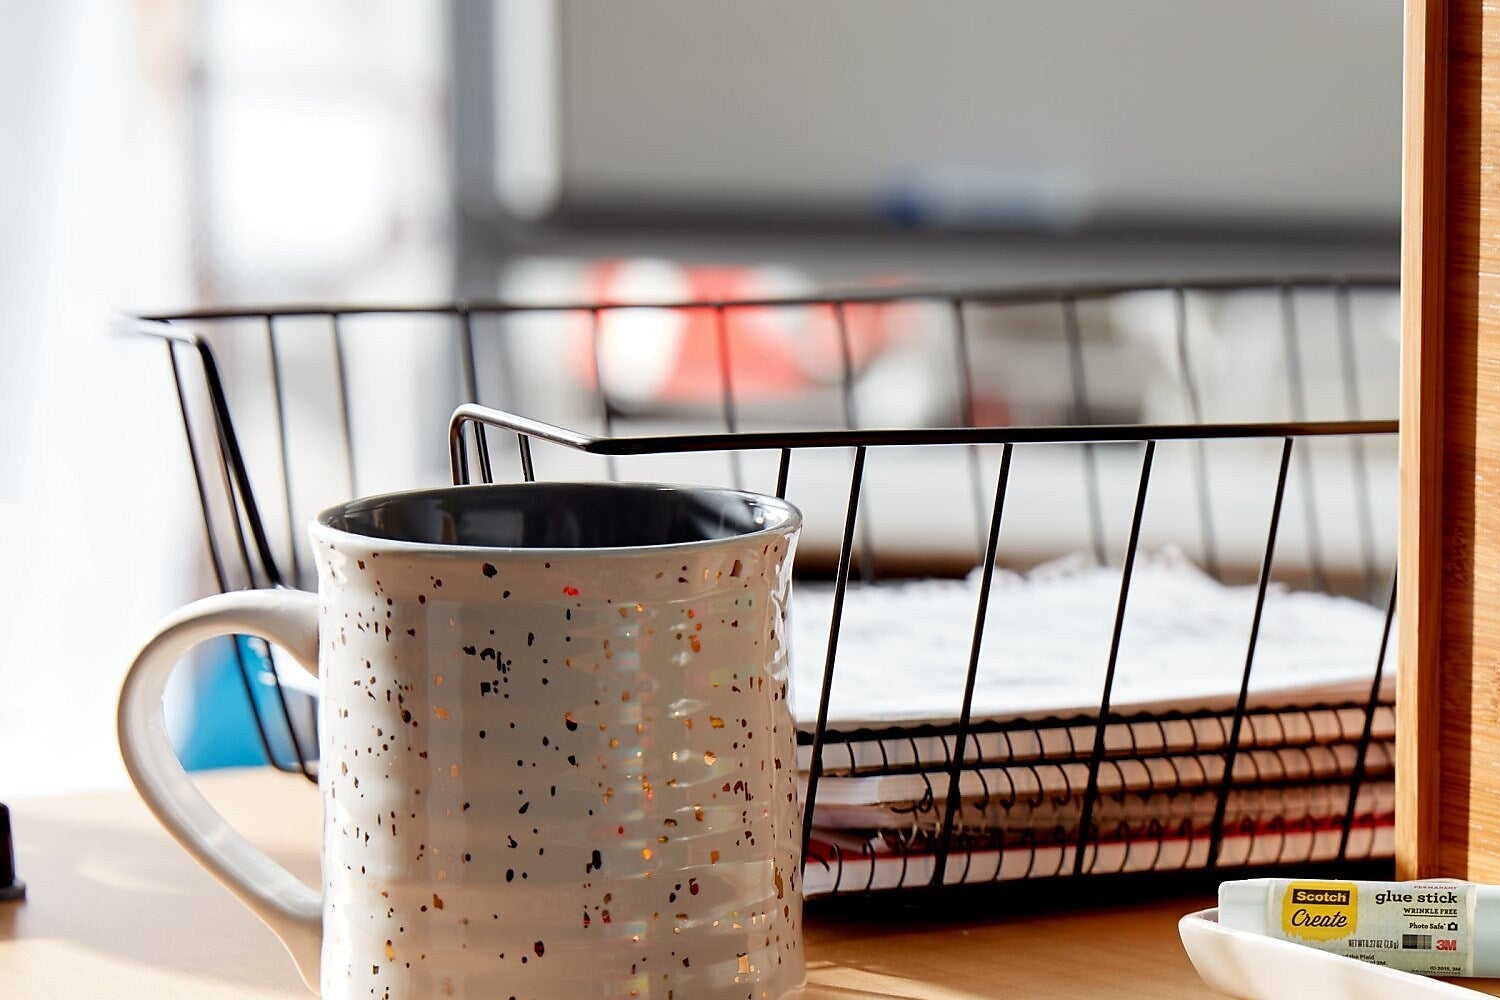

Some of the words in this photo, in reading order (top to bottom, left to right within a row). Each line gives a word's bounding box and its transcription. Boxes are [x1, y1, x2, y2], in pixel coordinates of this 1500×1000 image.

[1296, 891, 1347, 903] Scotch
[1375, 890, 1413, 905] glue
[1417, 891, 1458, 904] stick
[1403, 907, 1439, 915] WRINKLE
[1291, 908, 1348, 928] Create
[1409, 922, 1429, 930] Photo
[1436, 939, 1457, 951] 3M
